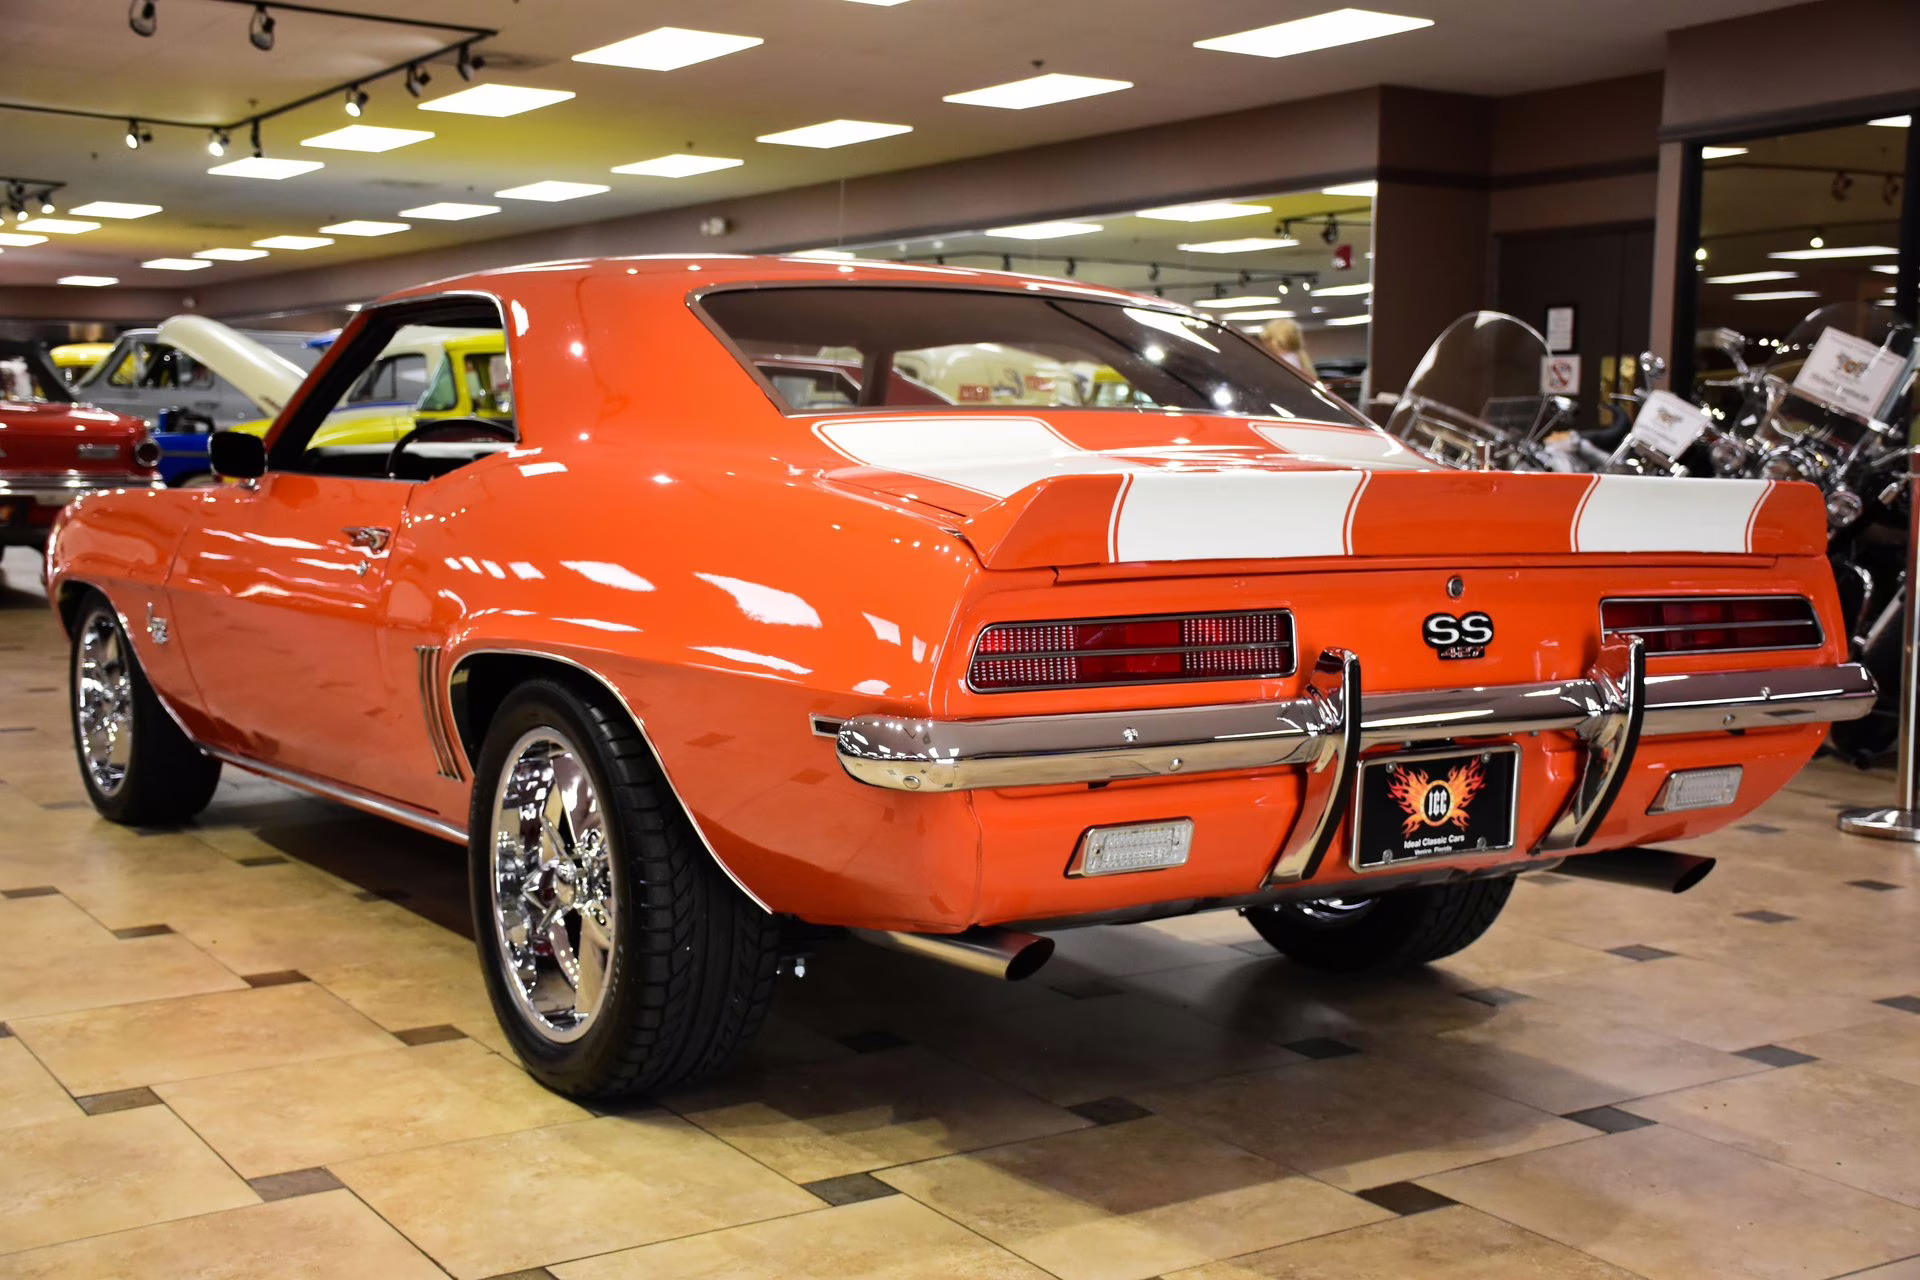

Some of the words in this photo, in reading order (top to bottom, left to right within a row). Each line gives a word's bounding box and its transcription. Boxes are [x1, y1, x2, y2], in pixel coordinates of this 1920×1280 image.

[1428, 614, 1493, 645] SS
[1428, 789, 1447, 816] ICC
[1403, 839, 1421, 849] Ideal
[1422, 836, 1447, 846] Classic
[1448, 834, 1465, 843] Cars
